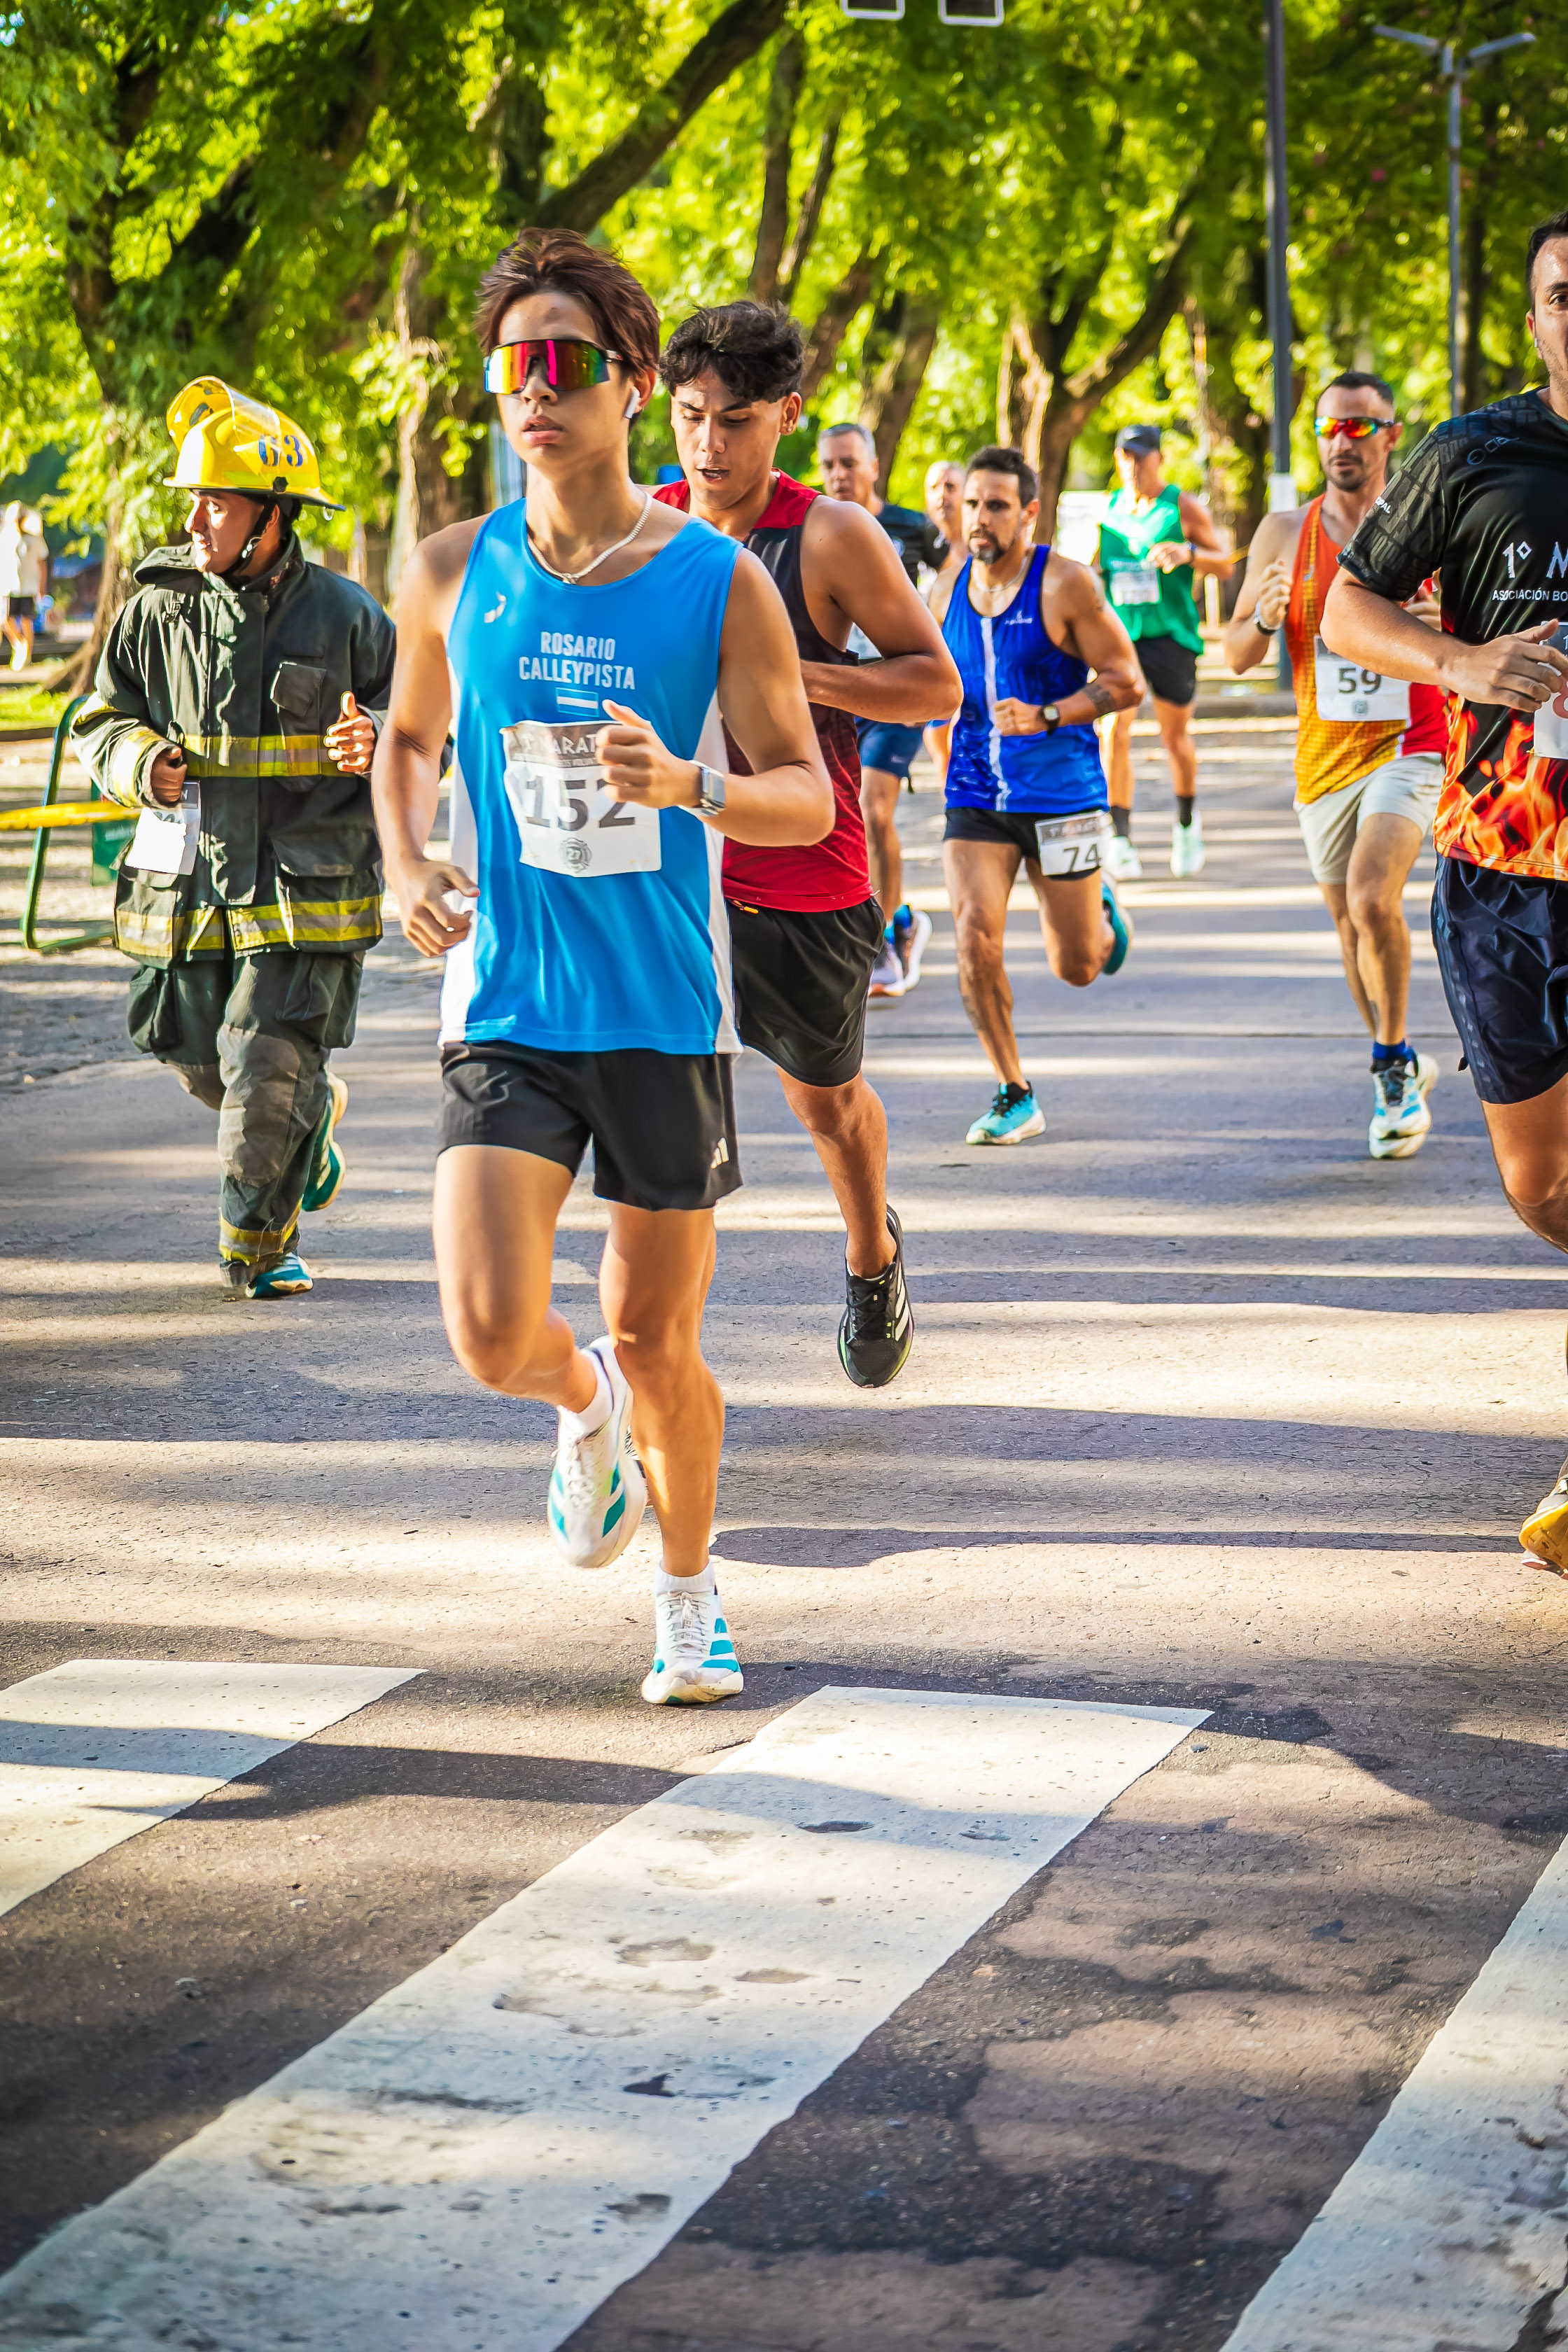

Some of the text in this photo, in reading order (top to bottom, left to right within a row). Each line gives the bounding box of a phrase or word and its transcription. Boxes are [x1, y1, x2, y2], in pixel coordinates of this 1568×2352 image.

[258, 434, 304, 468] 63
[1492, 587, 1550, 601] ASOCIACIÓN
[540, 631, 616, 661] ROSARIO
[519, 656, 636, 690] CALLEYPISTA
[1338, 666, 1382, 695] 59
[526, 775, 636, 832] 152
[1063, 844, 1101, 873] 74
